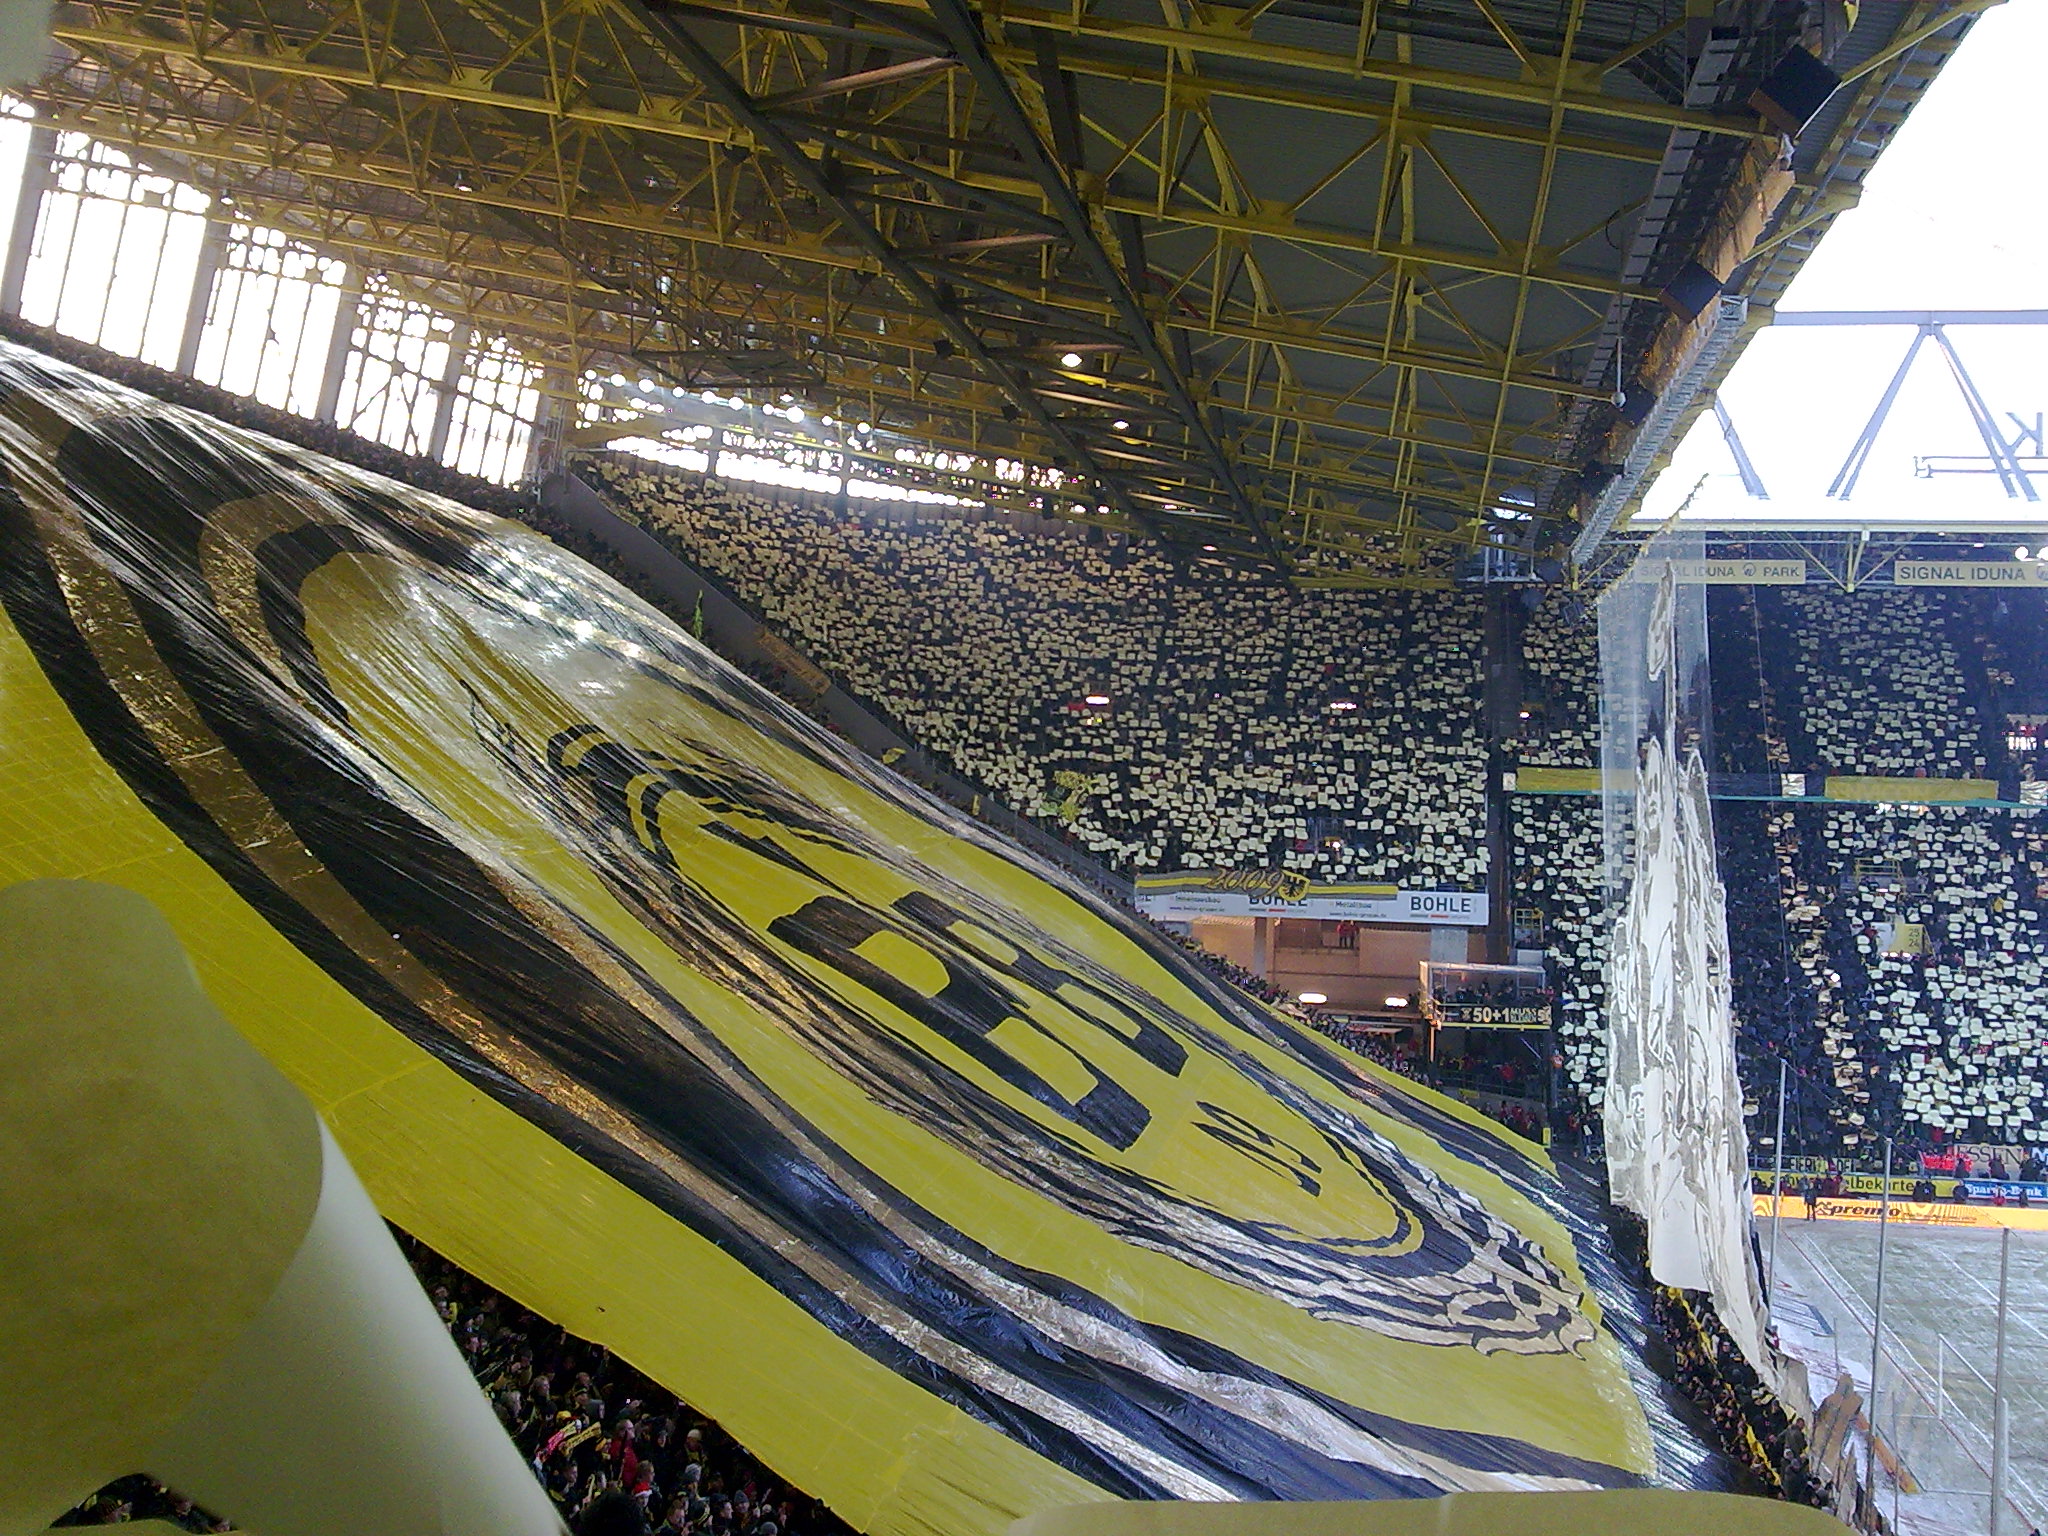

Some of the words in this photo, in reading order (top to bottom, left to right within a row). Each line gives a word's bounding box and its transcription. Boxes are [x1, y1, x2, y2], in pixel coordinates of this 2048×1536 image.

[1763, 566, 1800, 577] PARK
[1900, 566, 1965, 580] SIGNAL
[1971, 567, 2026, 580] IDUNA
[1207, 867, 1285, 899] 2009
[1410, 896, 1472, 913] BOHLE
[1473, 1007, 1509, 1023] 50+1
